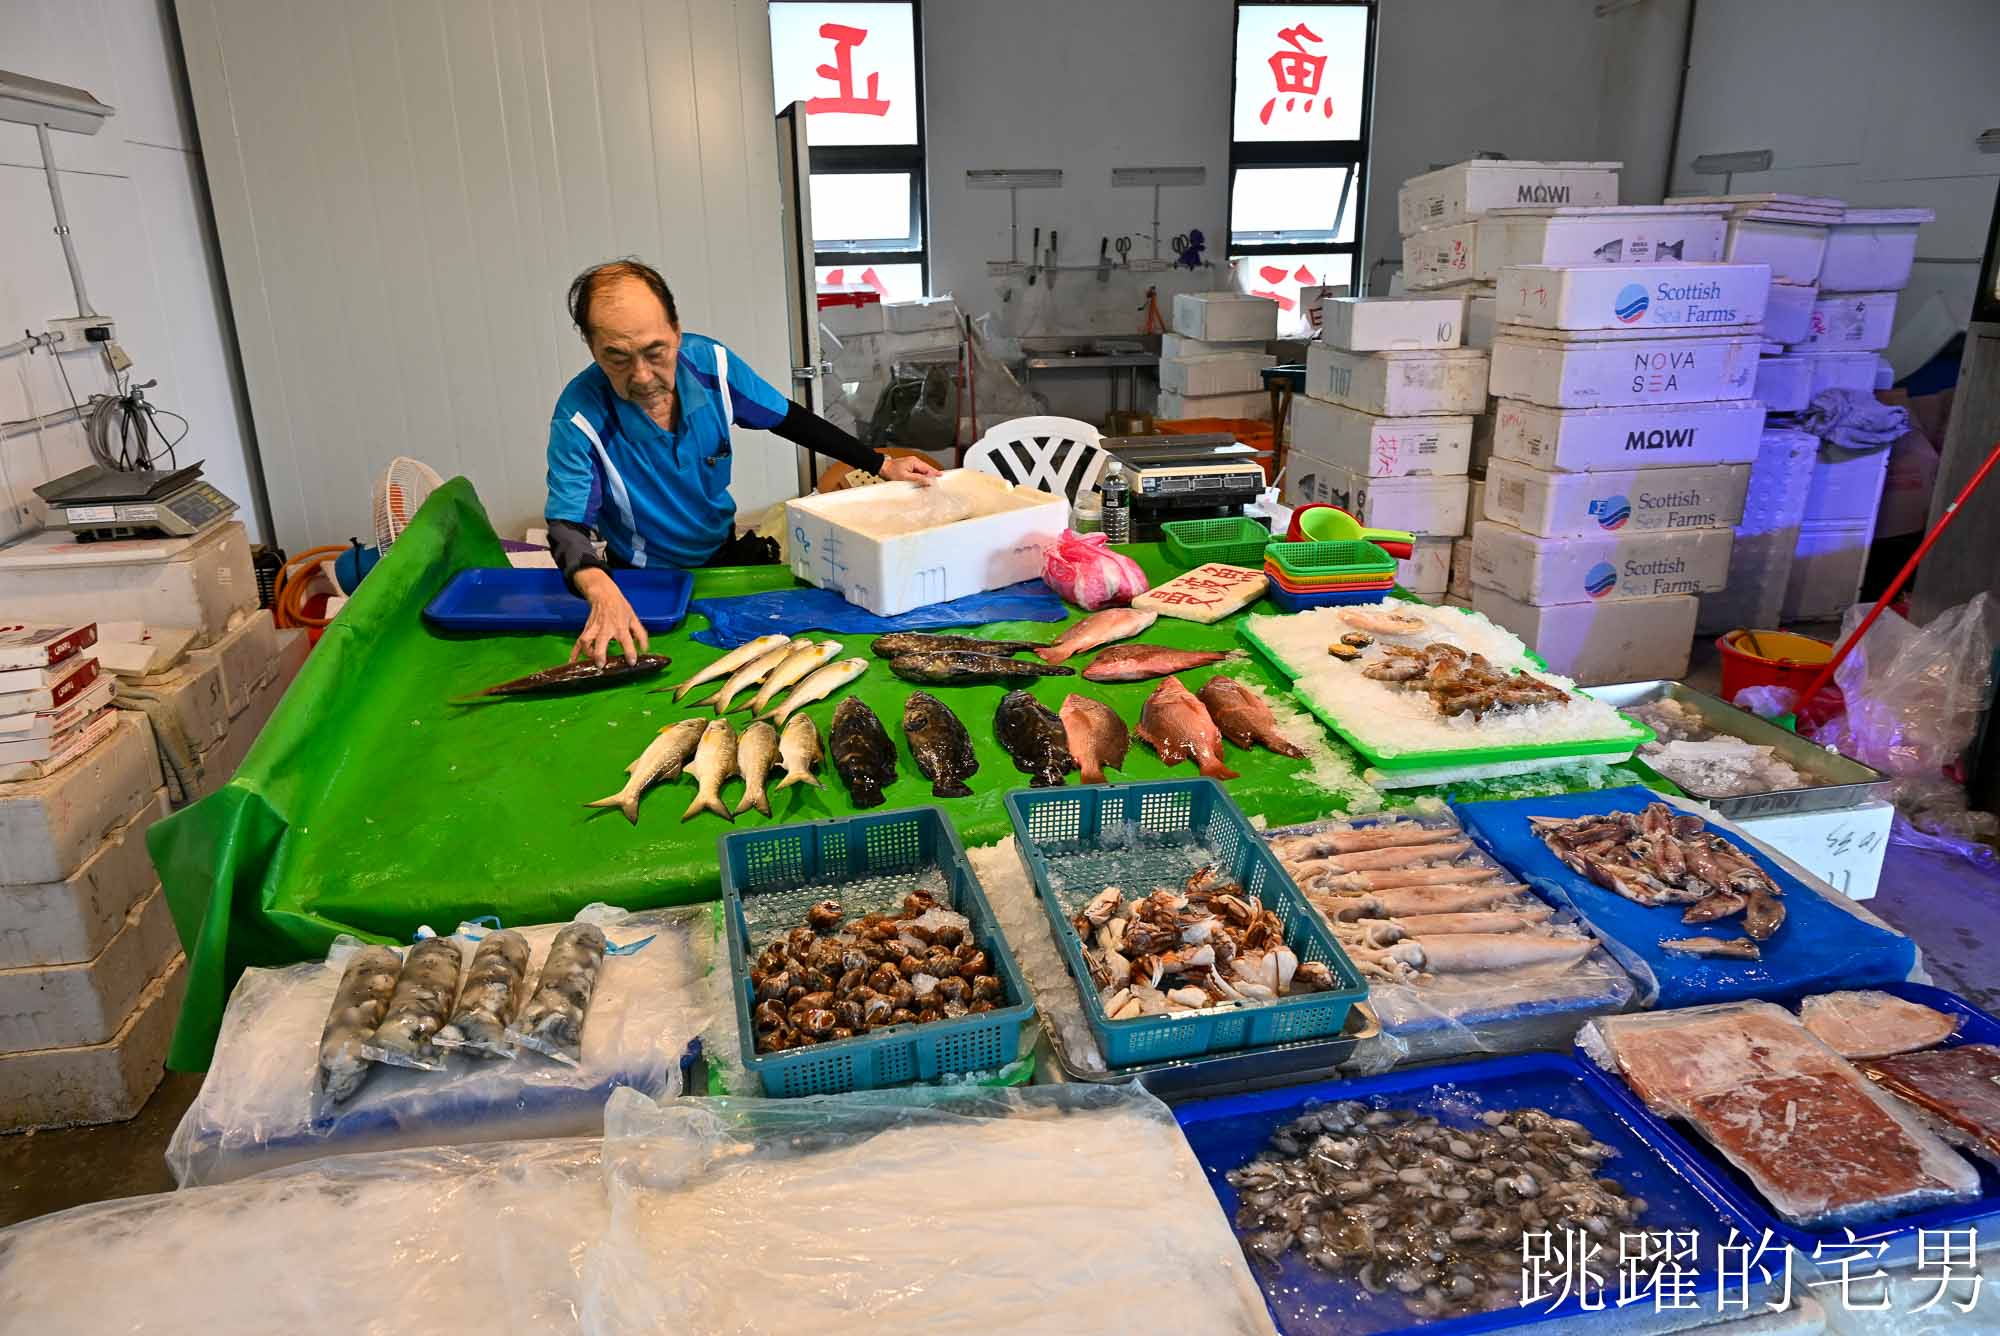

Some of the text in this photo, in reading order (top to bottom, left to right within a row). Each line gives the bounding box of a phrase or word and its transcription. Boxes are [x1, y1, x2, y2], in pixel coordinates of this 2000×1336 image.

[1656, 282, 1721, 302] Scottish
[1686, 304, 1737, 323] Farms
[1436, 321, 1452, 343] 10
[1633, 351, 1697, 371] NOVA
[1631, 374, 1679, 393] SEA
[1637, 490, 1701, 510] Scottish
[1667, 510, 1716, 529] Farms
[1623, 557, 1685, 578] Scottish
[1652, 577, 1701, 594] Farms
